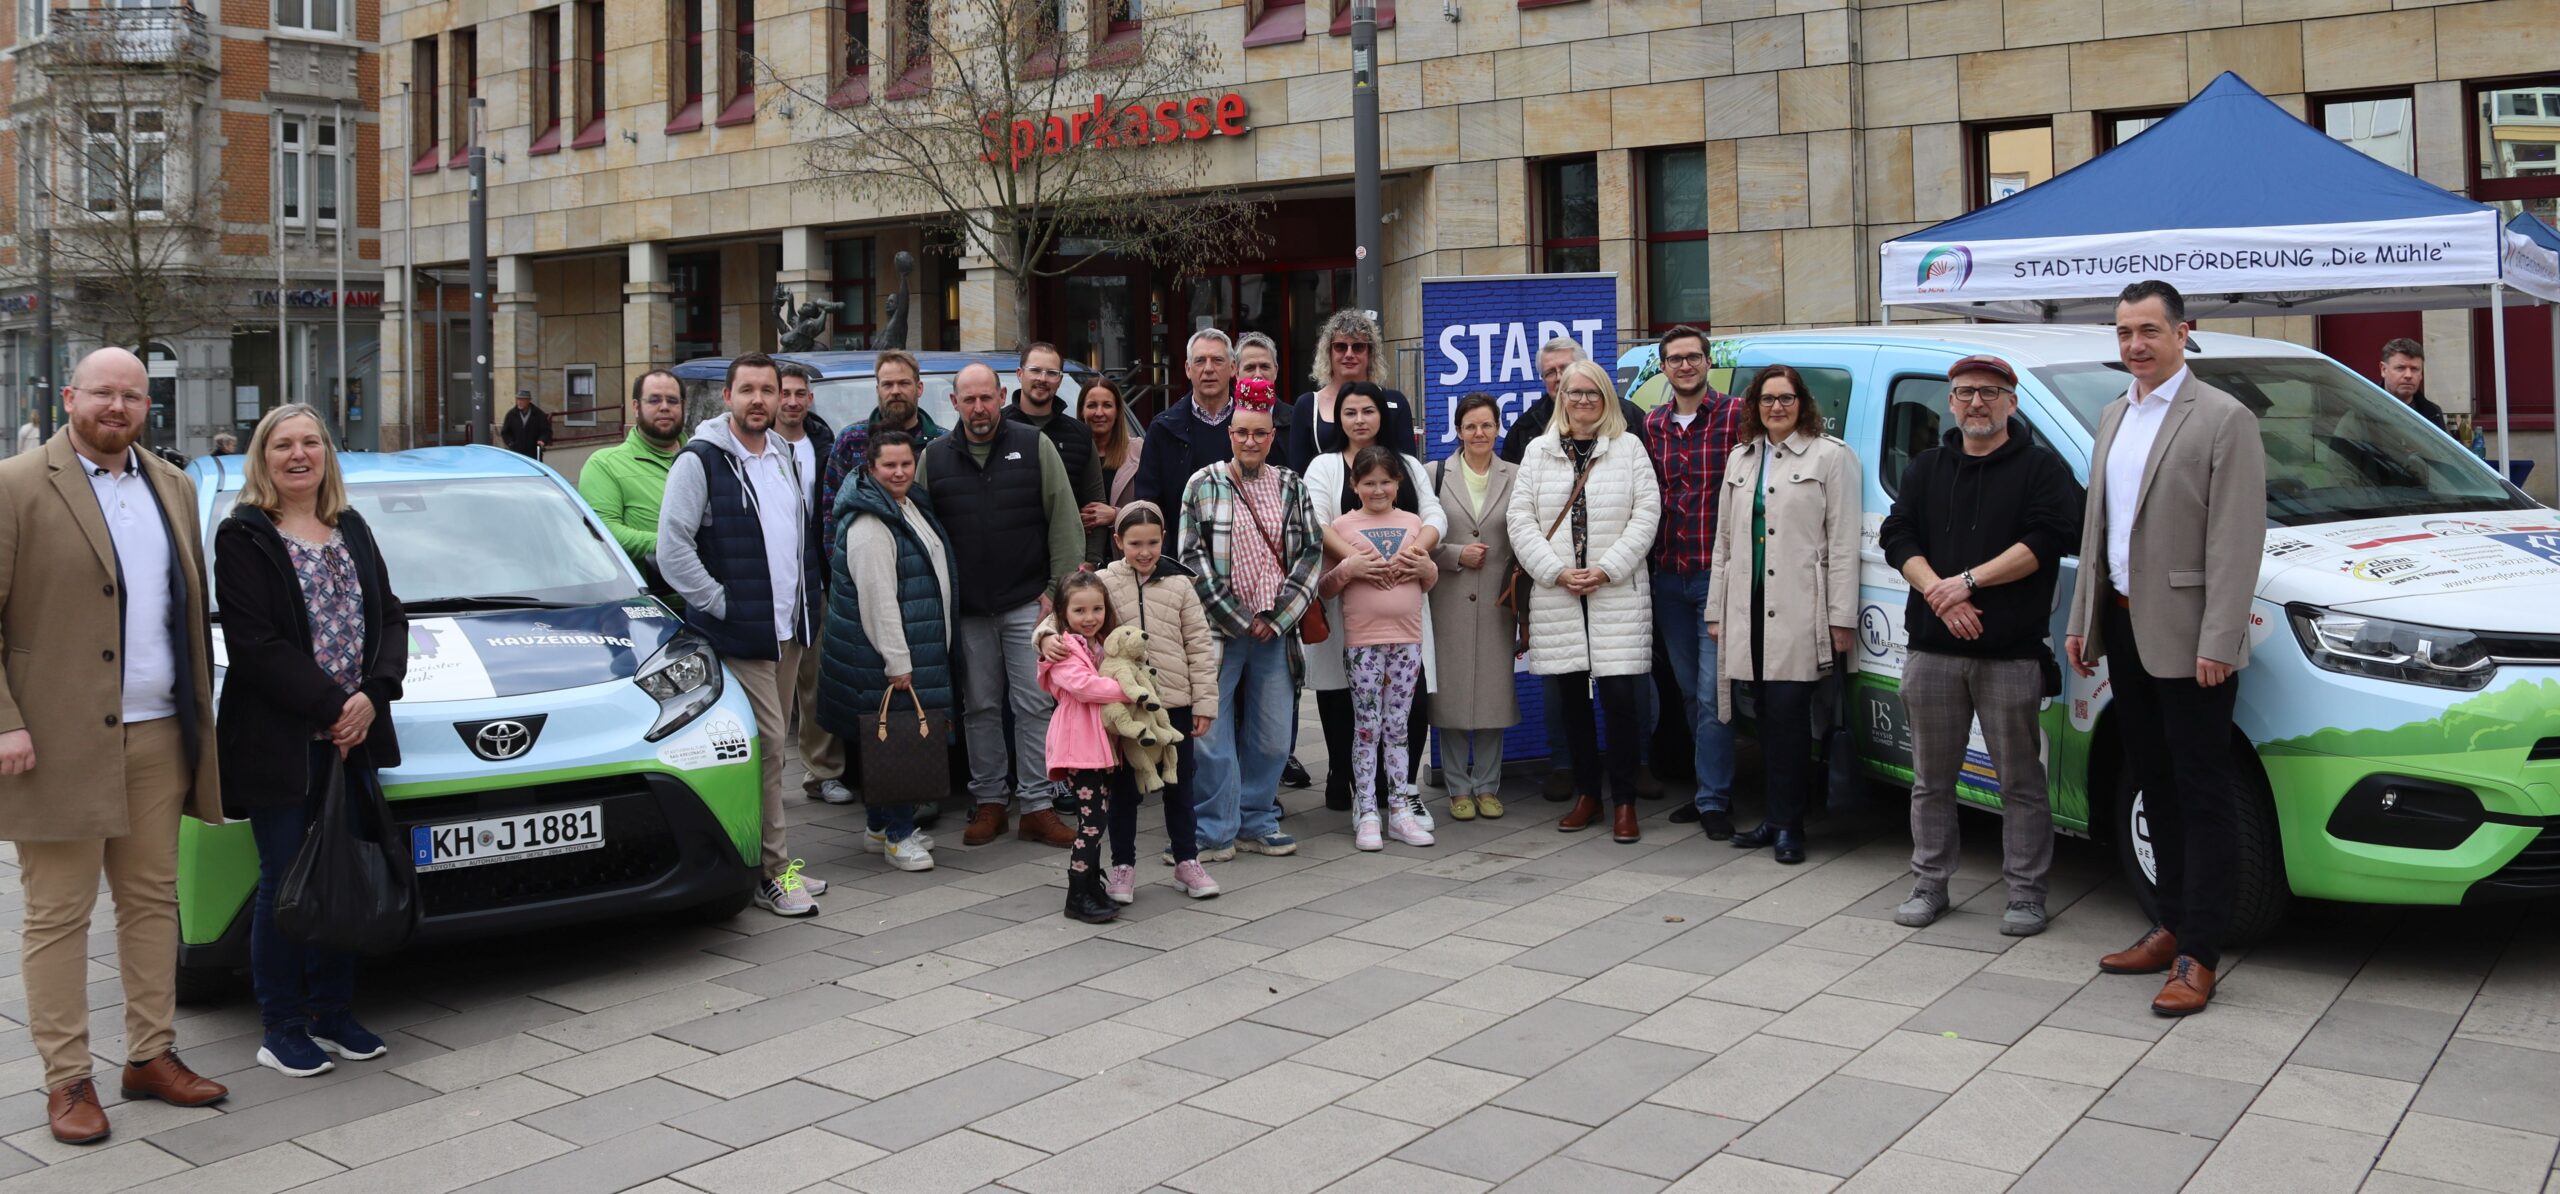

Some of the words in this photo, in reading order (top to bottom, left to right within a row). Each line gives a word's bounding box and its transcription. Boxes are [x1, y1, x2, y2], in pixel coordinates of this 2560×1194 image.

[978, 93, 1246, 173] Sparkasse
[2013, 248, 2315, 279] STADTJUGENDFÖRDERUNG
[2367, 556, 2412, 569] clean
[2369, 563, 2417, 578] force
[486, 635, 635, 649] KAUZENBURG
[1870, 699, 1892, 732] PS
[433, 826, 475, 859] KH
[497, 821, 516, 851] J
[523, 811, 597, 848] 1881
[419, 850, 427, 859] D
[431, 863, 456, 871] TOYOTA
